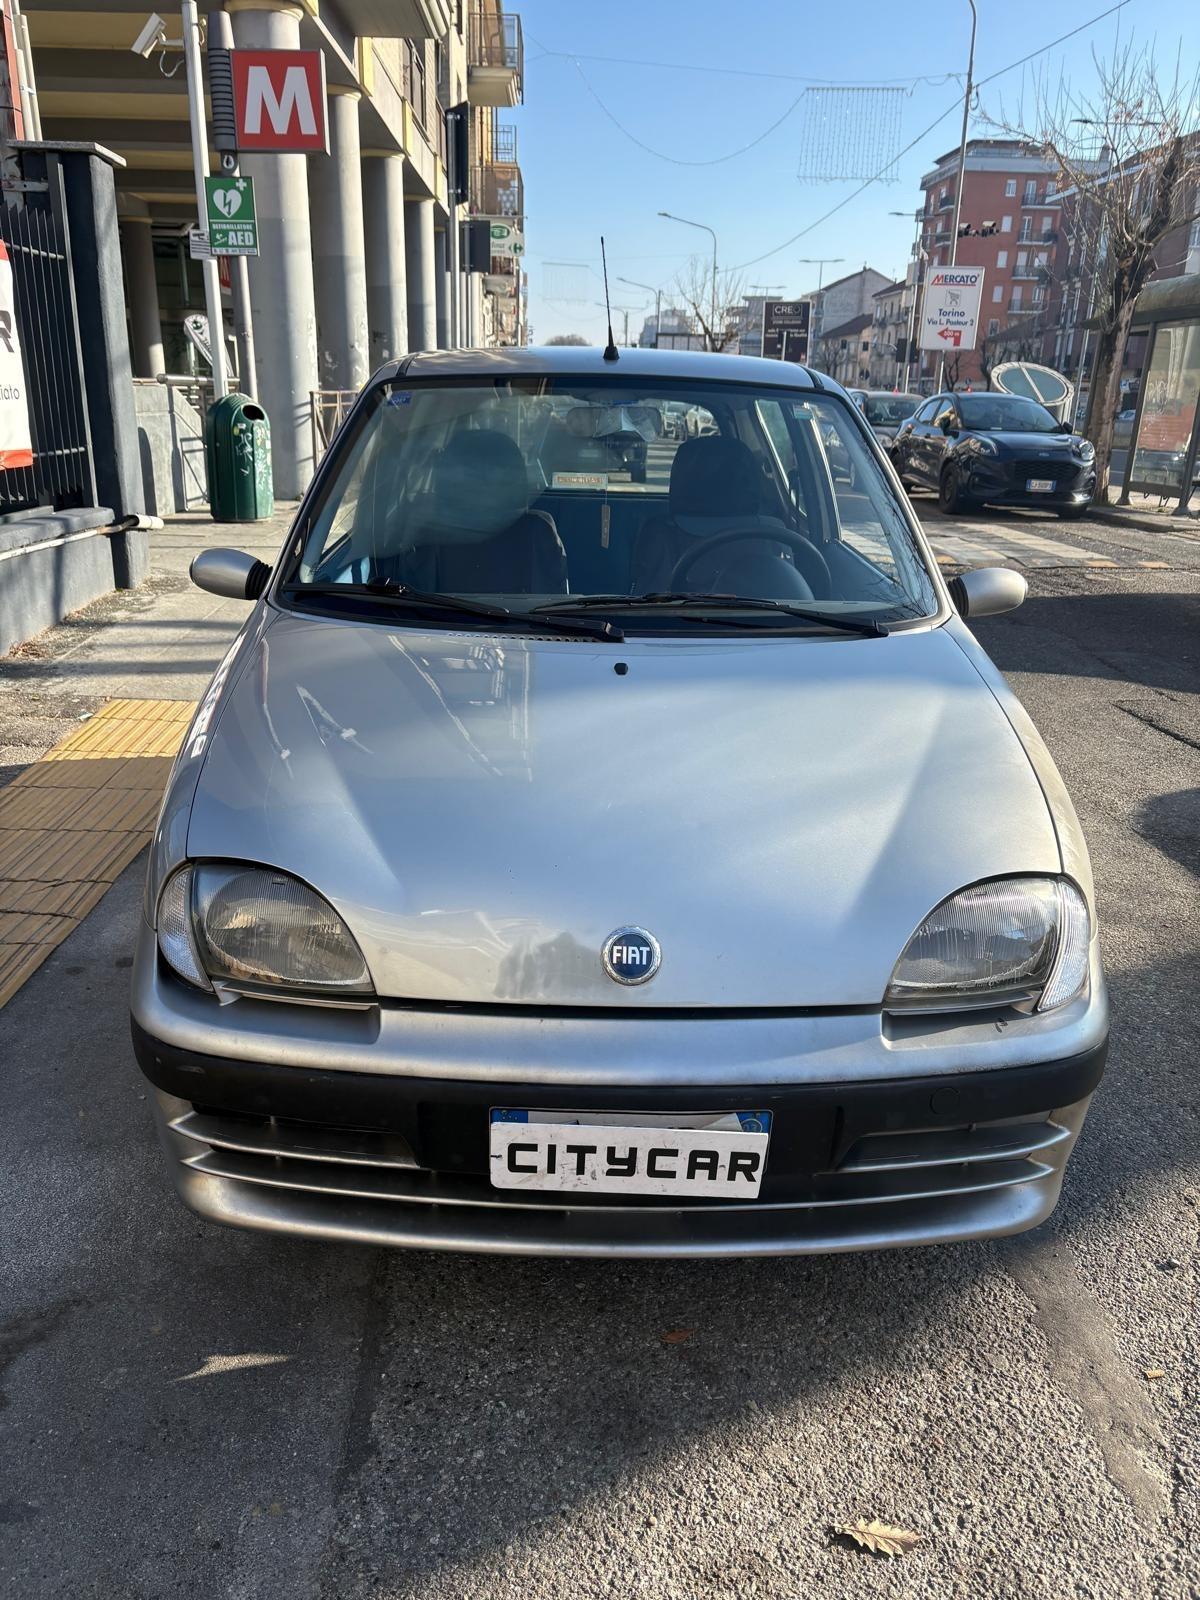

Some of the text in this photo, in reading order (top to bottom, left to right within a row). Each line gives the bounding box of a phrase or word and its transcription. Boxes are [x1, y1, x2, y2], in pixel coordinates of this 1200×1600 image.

[244, 65, 318, 135] M
[228, 231, 254, 246] AED
[938, 308, 966, 317] Torino
[612, 945, 651, 965] FIAT
[507, 1142, 761, 1182] CITYCAR
